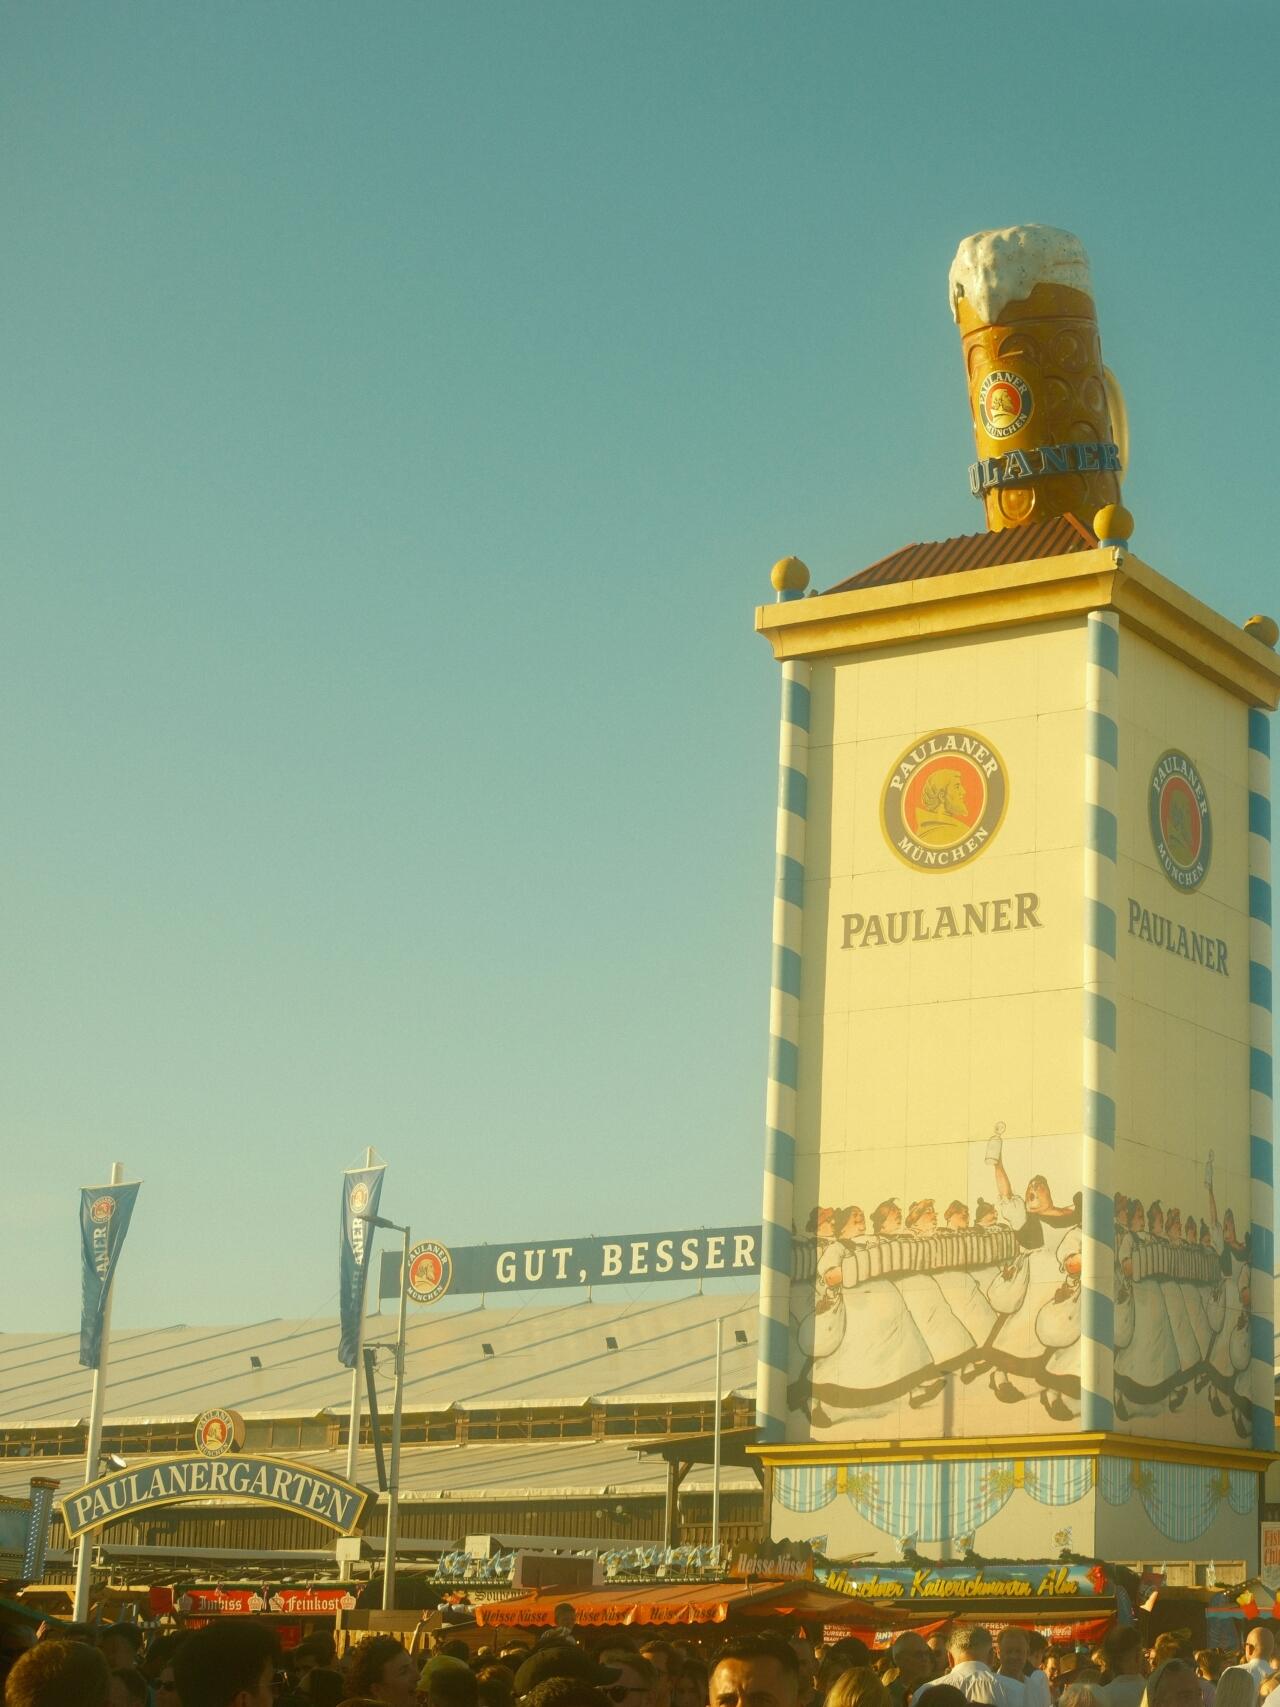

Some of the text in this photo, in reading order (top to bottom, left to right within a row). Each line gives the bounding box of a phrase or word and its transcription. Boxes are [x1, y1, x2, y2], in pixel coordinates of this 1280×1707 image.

[980, 372, 1028, 405] PAULANER
[890, 735, 998, 791] PAULANER
[1152, 756, 1208, 816] PAULANER
[898, 826, 989, 865] MÜNCHEN
[841, 892, 1042, 949] PAULANER
[1127, 897, 1230, 977] PAULANER
[496, 1234, 756, 1284] GUT, BESSER
[73, 1461, 352, 1527] PAULANERGARTEN
[738, 1553, 808, 1576] Heisse Nüsse
[1037, 1567, 1078, 1596] Alm
[199, 1595, 242, 1611] Imbiss
[286, 1595, 339, 1612] Feinkost
